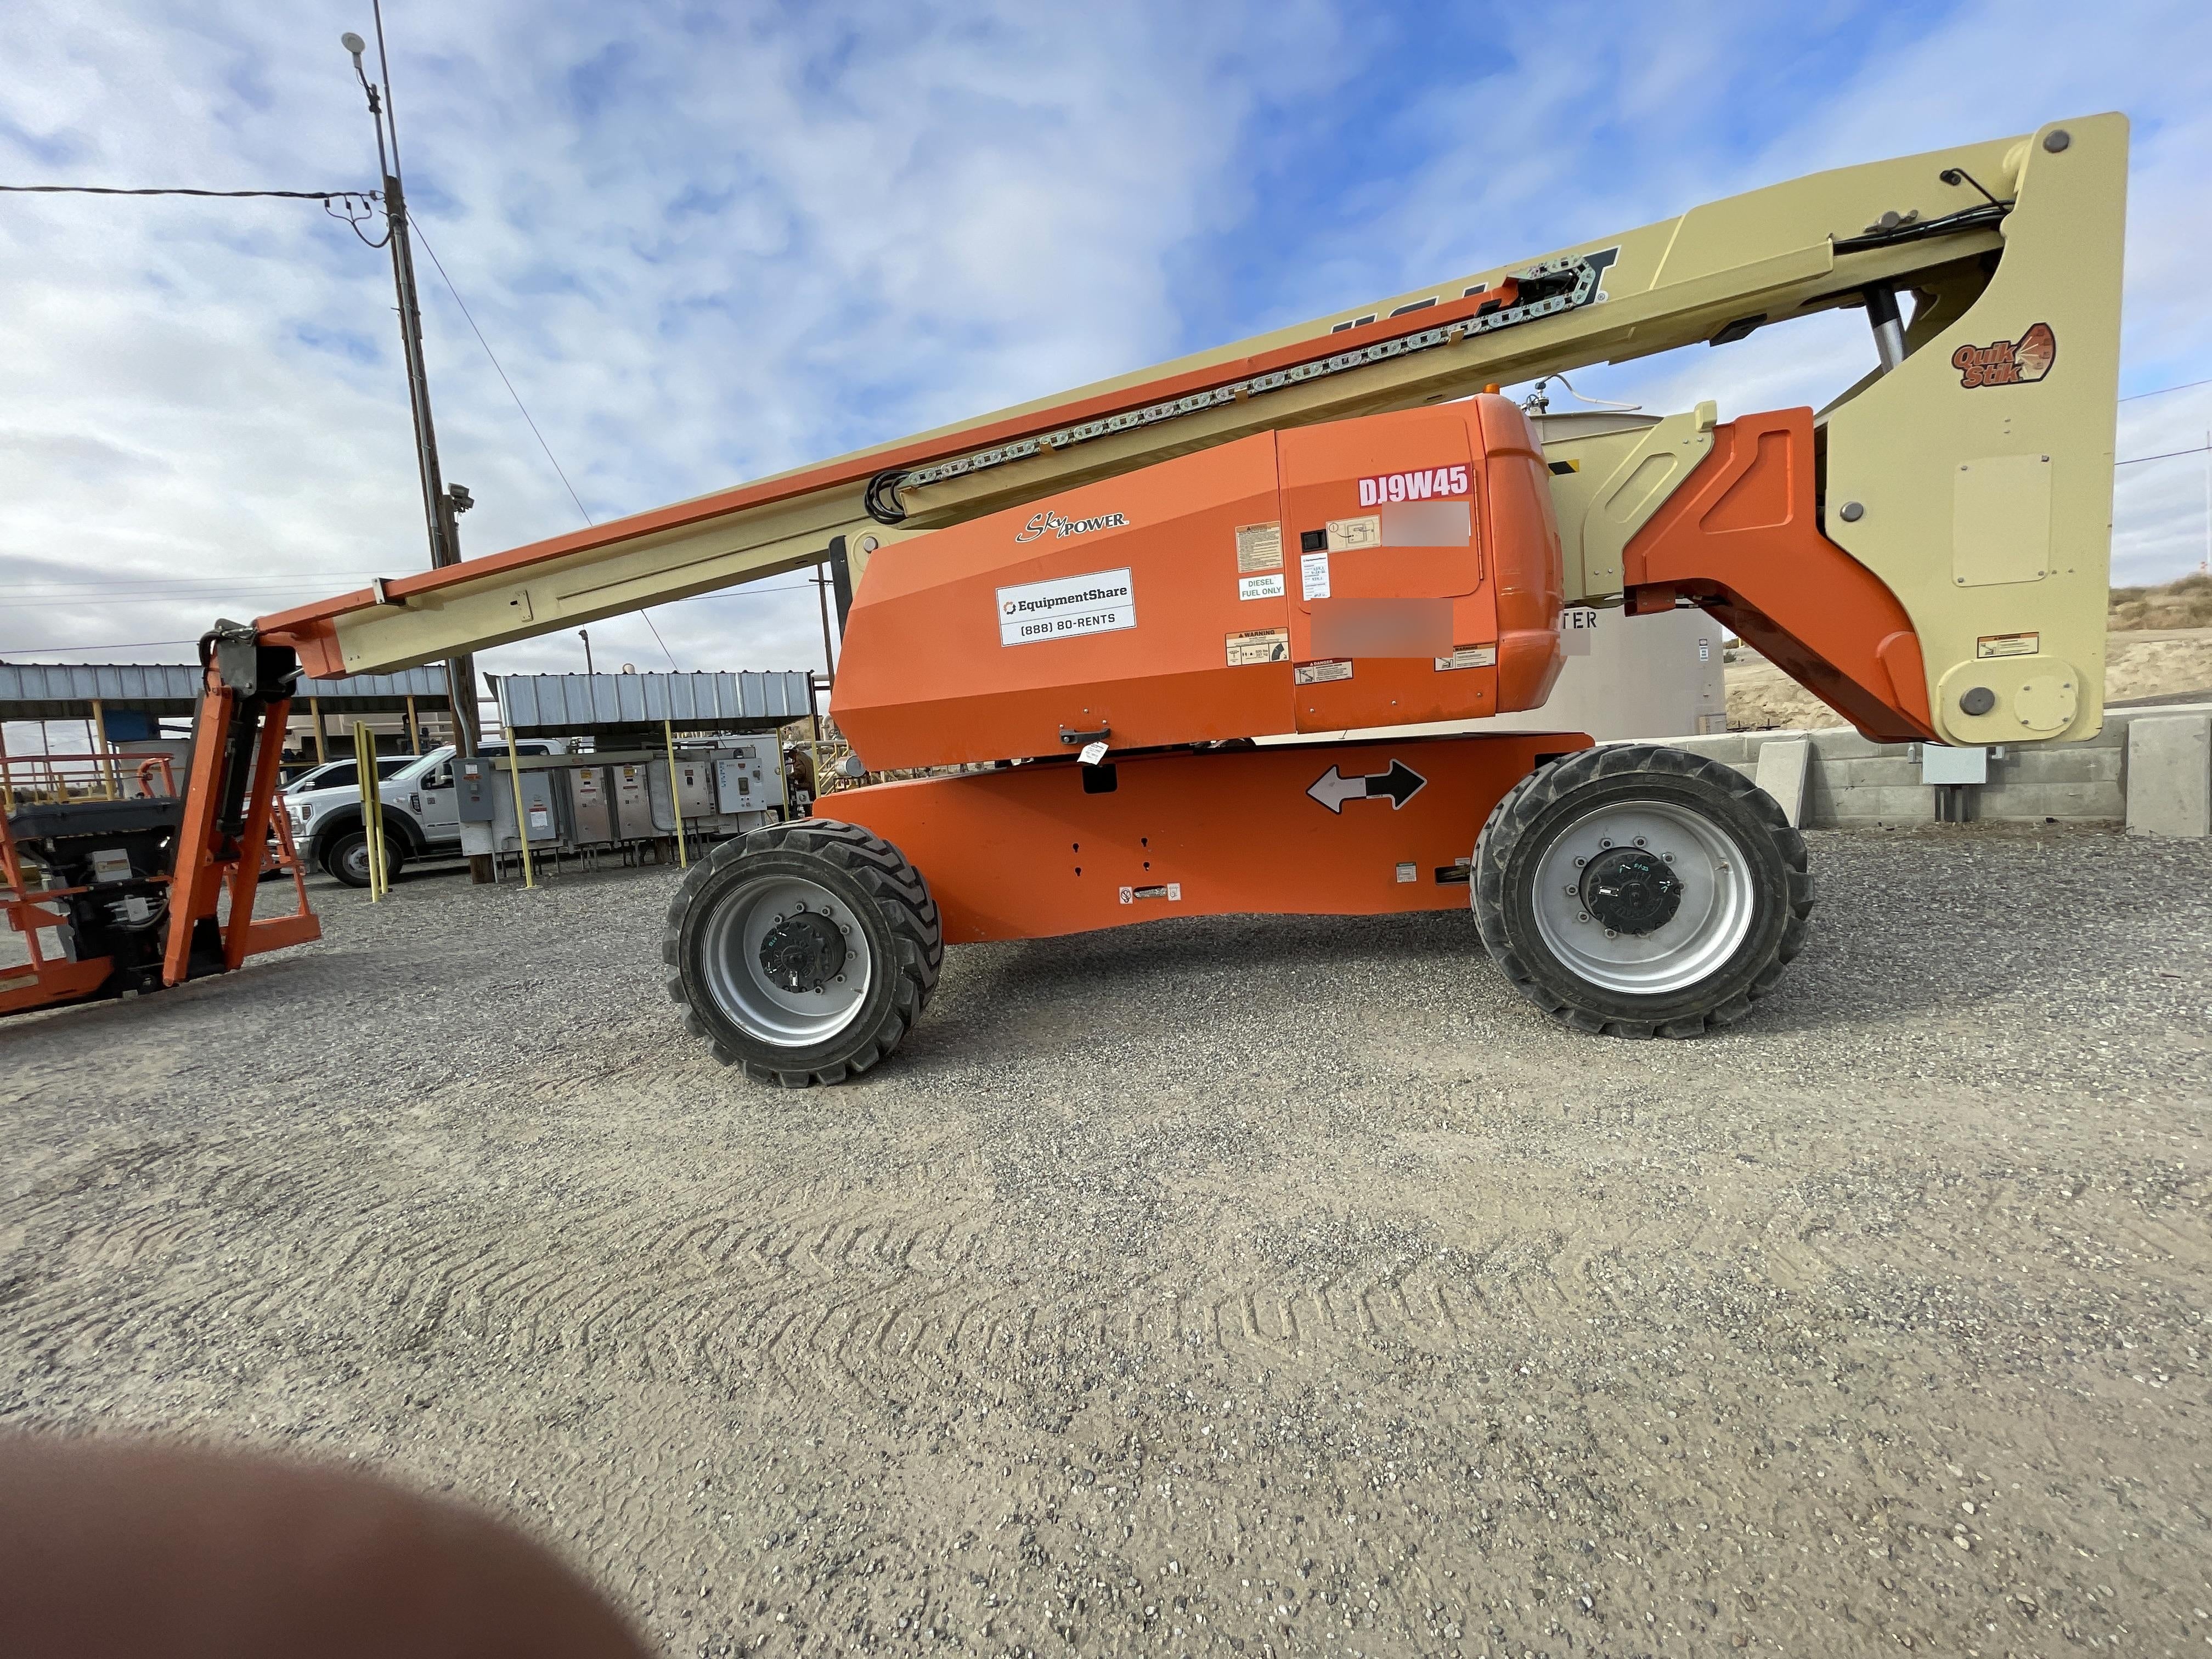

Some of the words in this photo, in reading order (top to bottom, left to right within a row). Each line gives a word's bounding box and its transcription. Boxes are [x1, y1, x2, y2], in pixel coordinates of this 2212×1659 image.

[1953, 342, 2018, 370] Quik
[1962, 363, 2022, 387] Stik
[1359, 466, 1468, 506] DJ9W45
[1248, 578, 1274, 587] DIESEL
[1262, 586, 1282, 595] ONLY
[1018, 586, 1128, 612] EquipmentShare
[1021, 622, 1053, 636] (888)
[1057, 613, 1115, 630] 80-RENTS
